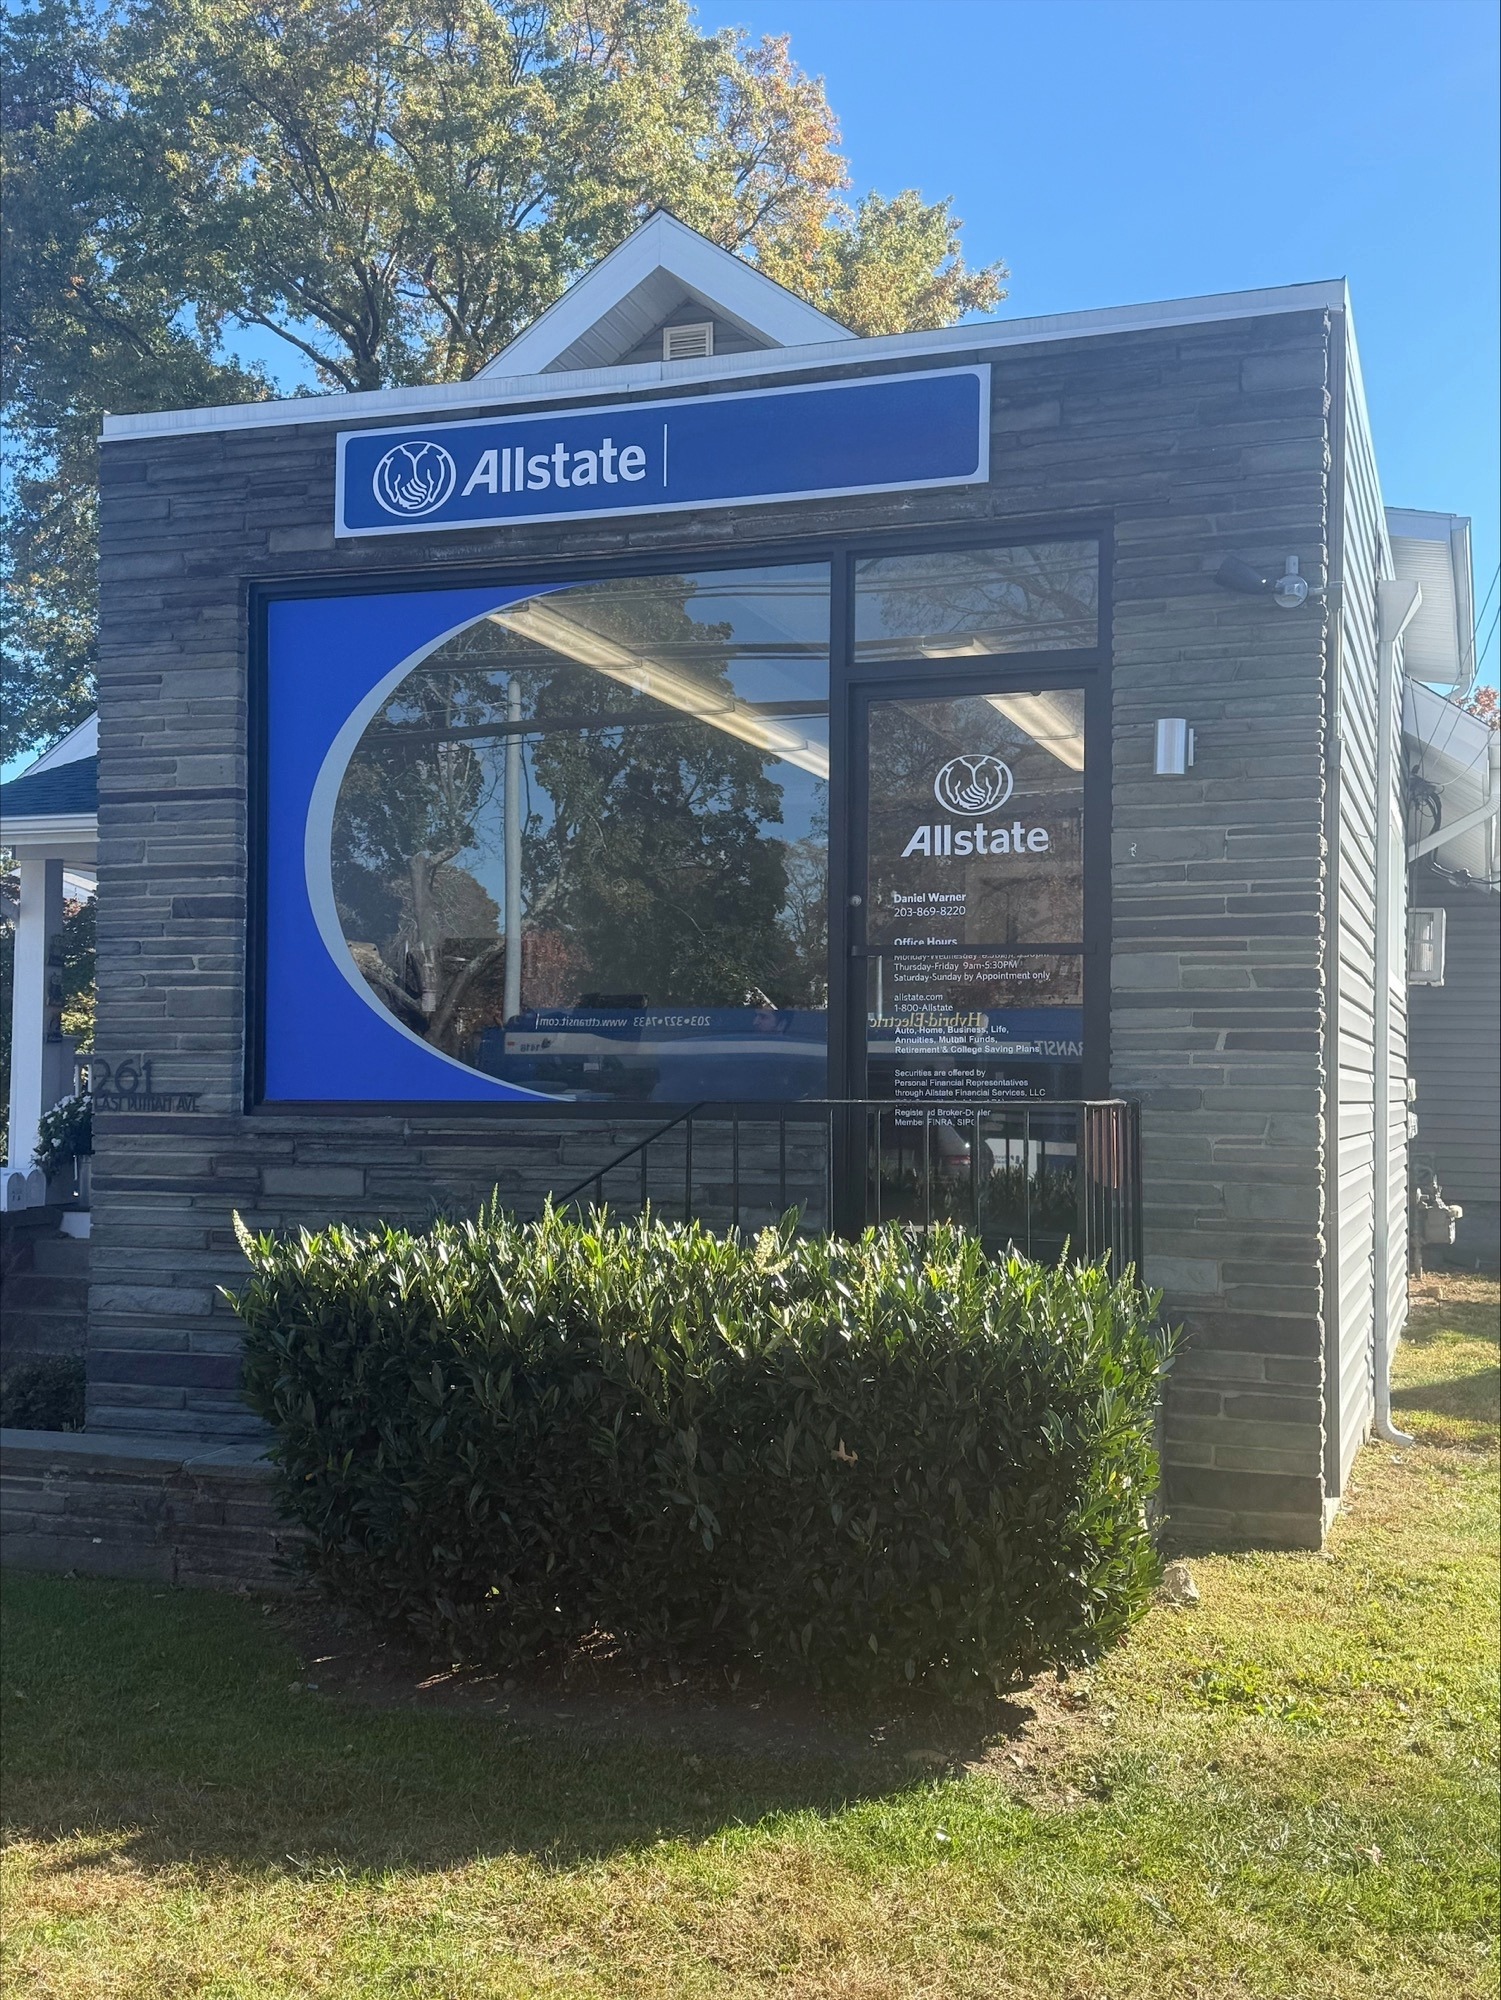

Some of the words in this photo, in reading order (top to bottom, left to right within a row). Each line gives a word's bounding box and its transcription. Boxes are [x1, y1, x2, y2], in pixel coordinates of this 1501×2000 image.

[461, 438, 647, 496] Allstate
[900, 821, 1049, 858] Allstate
[893, 893, 926, 904] Daniel
[928, 892, 967, 903] Warner
[893, 906, 966, 917] 203-869-8220
[927, 937, 957, 945] Hours
[894, 962, 959, 971] Thursday-Friday
[963, 961, 1017, 969] 9am-5:30PM
[894, 973, 962, 982] Saturday-Sunday
[964, 973, 974, 982] by
[976, 971, 1030, 980] Appointment
[1033, 971, 1050, 980] only
[894, 993, 943, 1001] allstate.com
[894, 1004, 953, 1012] 1-800-Allstate
[895, 1027, 917, 1035] Auto,
[948, 1026, 988, 1034] Business,
[895, 1036, 936, 1044] Annuities,
[951, 1045, 982, 1054] College
[985, 1045, 1013, 1054] Saving
[1016, 1045, 1040, 1053] Plans
[92, 1058, 153, 1095] 261
[895, 1069, 931, 1077] Securities
[977, 1069, 986, 1077] by
[966, 1079, 1028, 1087] Representatives
[895, 1089, 923, 1097] through
[992, 1089, 1027, 1097] Services,
[94, 1096, 122, 1112] EAST
[176, 1096, 201, 1112] AVE
